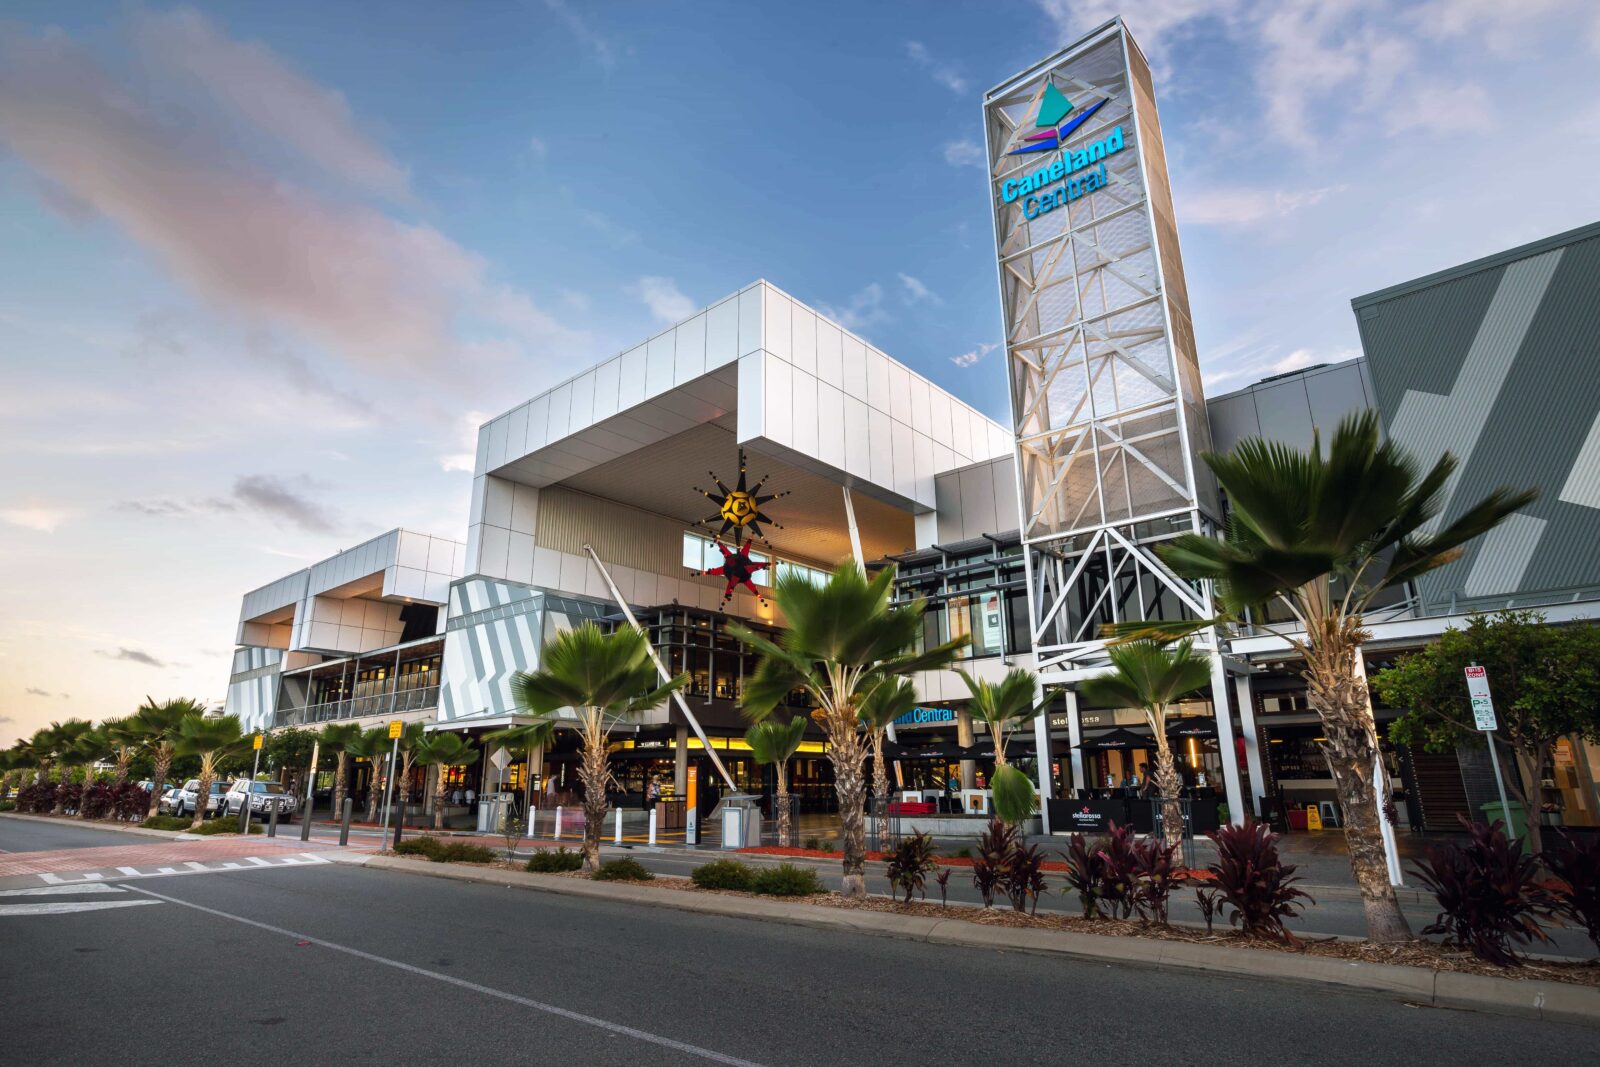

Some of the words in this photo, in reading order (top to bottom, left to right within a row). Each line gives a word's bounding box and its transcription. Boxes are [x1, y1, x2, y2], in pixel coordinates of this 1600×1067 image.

[1001, 125, 1124, 204] Caneland
[1022, 162, 1108, 221] Central
[913, 707, 953, 723] Central
